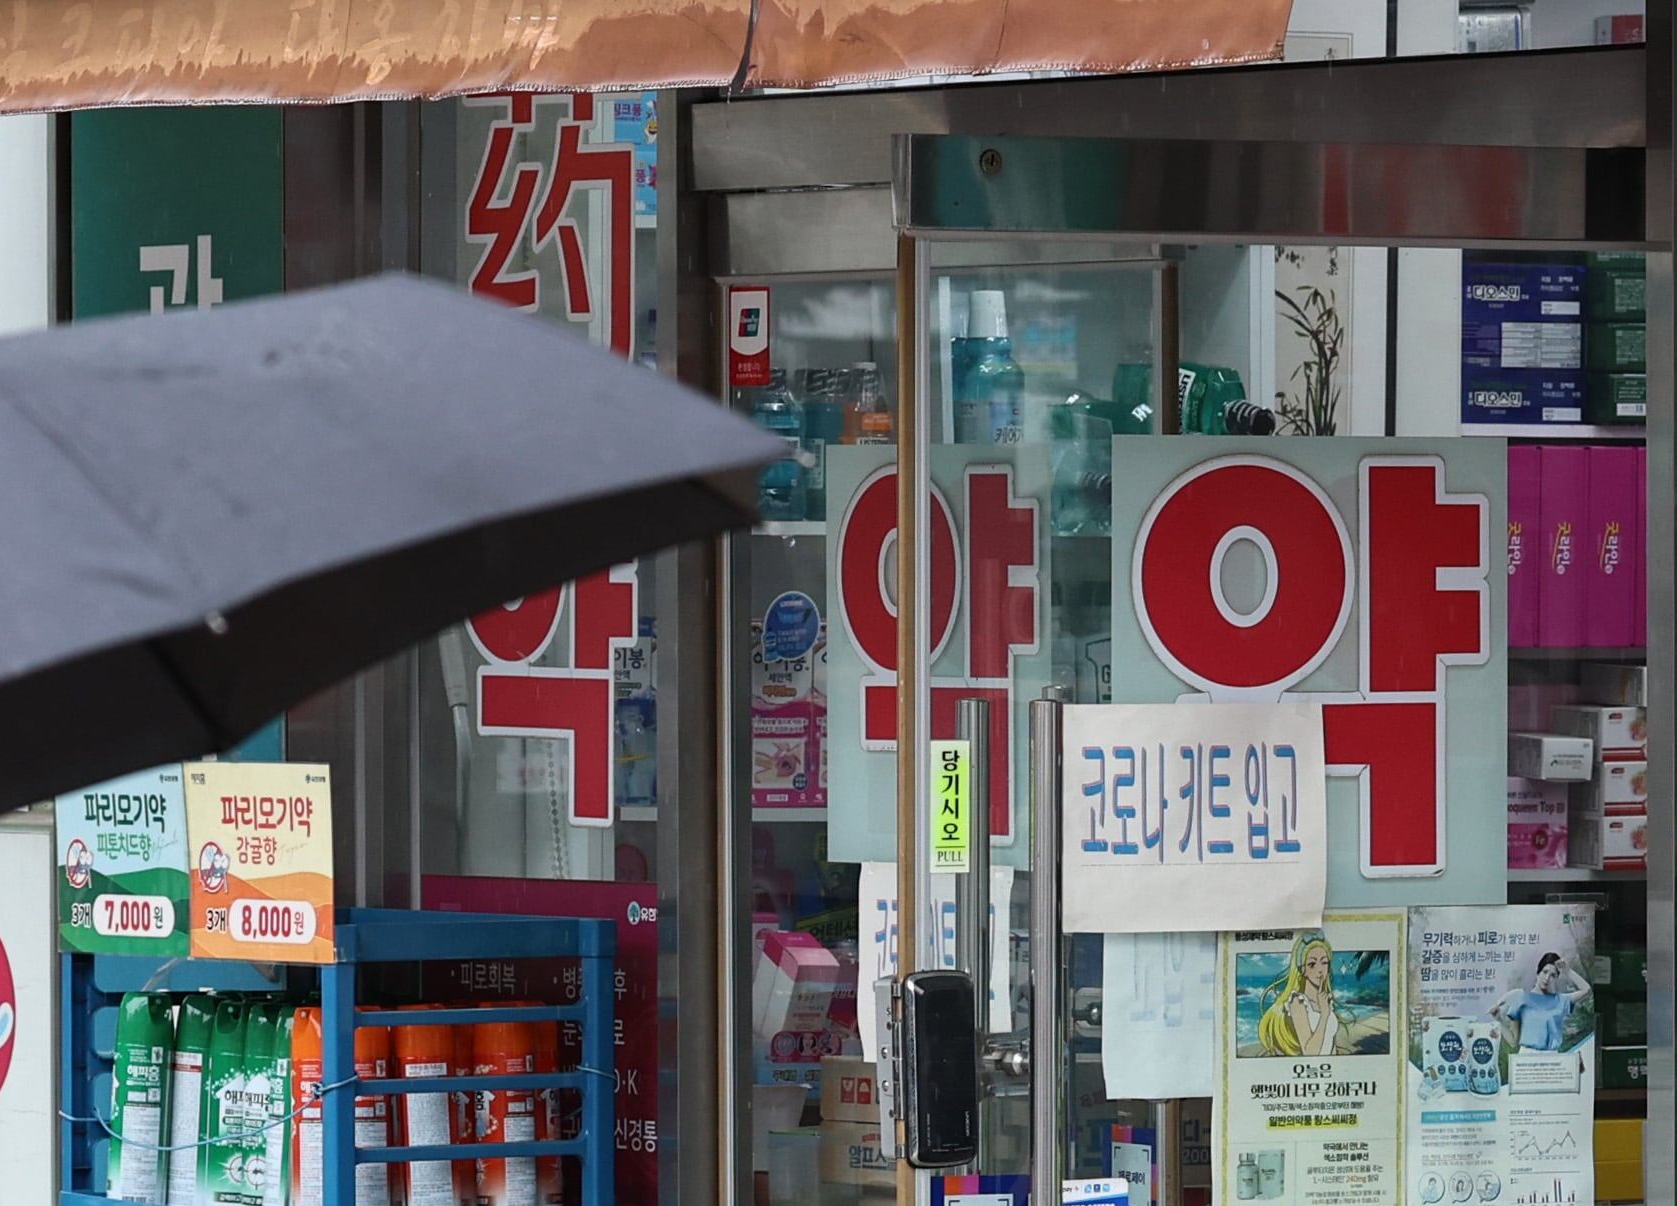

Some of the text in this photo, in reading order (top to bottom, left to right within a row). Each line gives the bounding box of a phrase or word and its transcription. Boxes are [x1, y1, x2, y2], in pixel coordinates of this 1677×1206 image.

[839, 470, 1036, 838] 약
[1139, 462, 1483, 868] 약
[940, 749, 961, 842] 당기시오
[1081, 741, 1301, 864] 코로나 키트 입고
[83, 793, 167, 834] 파리모기약
[220, 795, 314, 838] 파리모기약
[96, 833, 152, 862] 피톤치드향
[235, 837, 279, 866] 감귤향
[936, 850, 964, 863] PULL
[72, 904, 92, 926] 3개
[205, 909, 227, 933] 3개
[1423, 932, 1476, 946] 무기력하거나
[1477, 930, 1507, 946] 피로가
[1422, 950, 1451, 964] 갈증을
[1453, 951, 1476, 963] 심하게
[460, 962, 517, 992] 피로회복
[1292, 1063, 1333, 1080] 오늘은
[1251, 1081, 1376, 1099] 햇빛이 너무 강하구나
